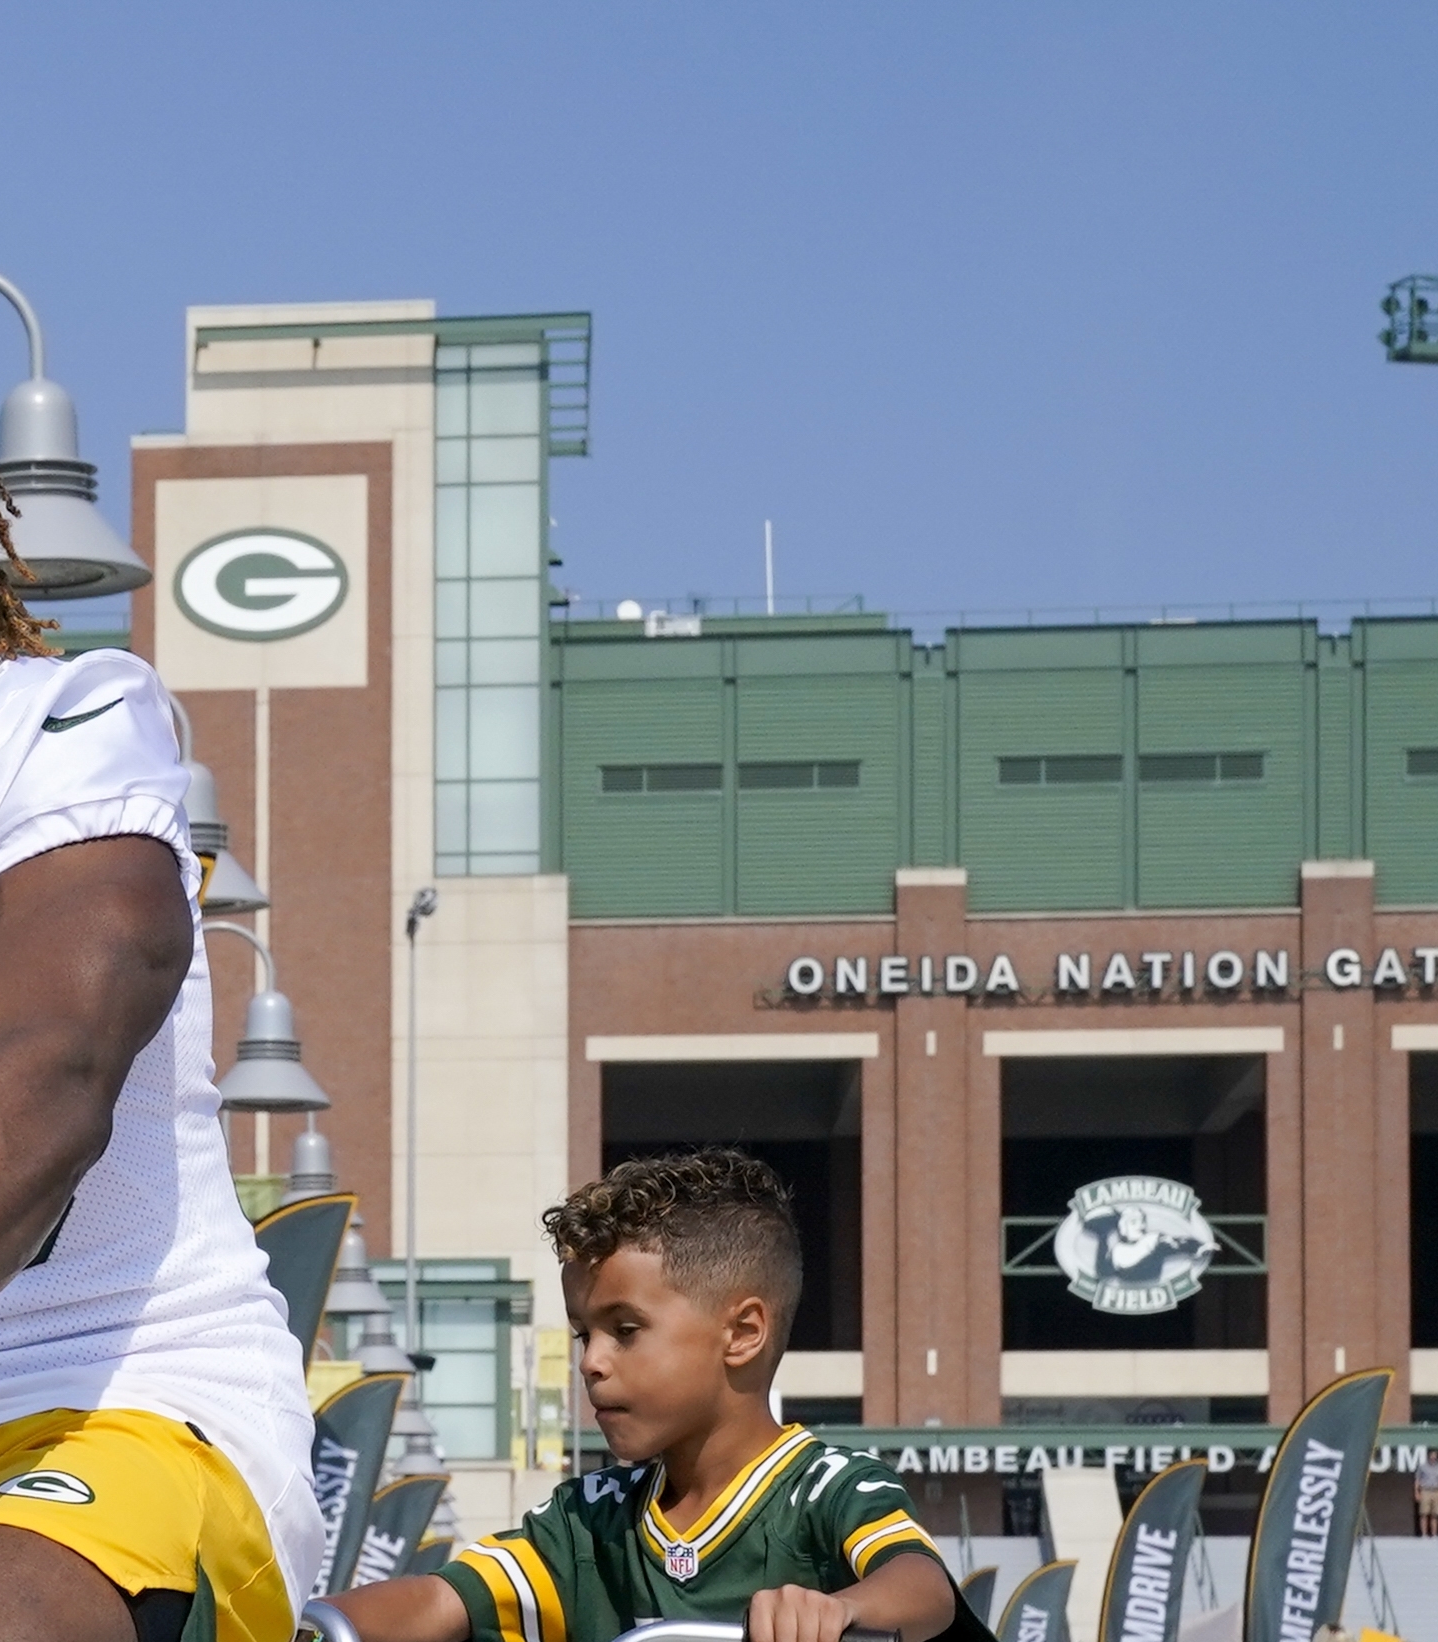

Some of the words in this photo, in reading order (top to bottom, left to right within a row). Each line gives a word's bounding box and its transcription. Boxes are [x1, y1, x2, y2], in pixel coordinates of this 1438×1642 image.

[787, 953, 1020, 995] ONEIDA
[1057, 950, 1288, 991] NATION
[1326, 947, 1438, 987] GAT
[1081, 1179, 1190, 1211] LAMBEAU
[1099, 1285, 1168, 1310] FIELD
[869, 1444, 1084, 1474] AMBEAU
[670, 1558, 693, 1574] NFL
